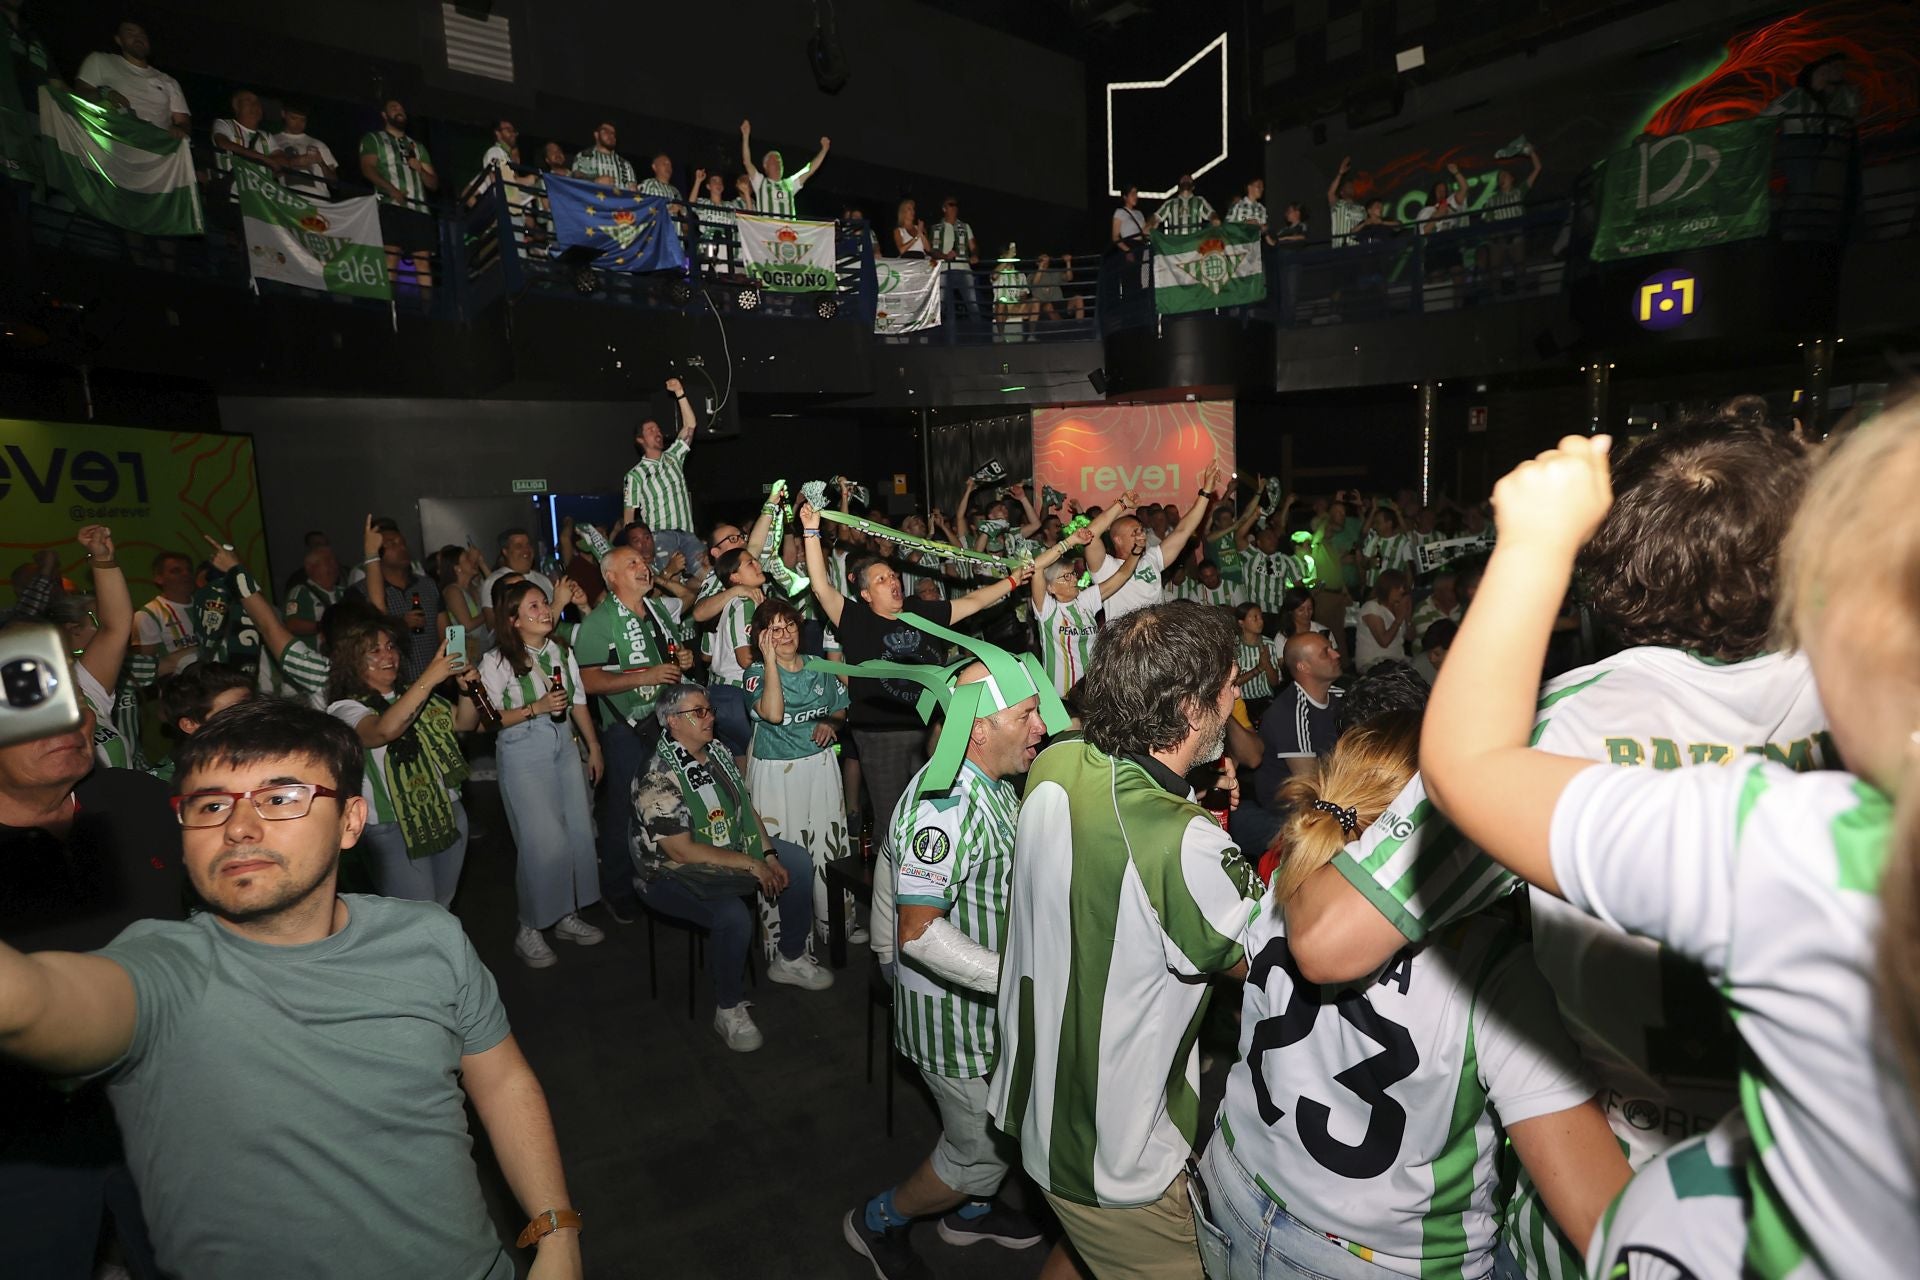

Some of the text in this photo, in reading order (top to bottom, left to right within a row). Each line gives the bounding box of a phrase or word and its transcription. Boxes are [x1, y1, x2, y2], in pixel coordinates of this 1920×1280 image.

[338, 256, 386, 286] alé!
[623, 618, 650, 665] Peña
[902, 866, 948, 883] FOUNDATION
[1247, 936, 1420, 1180] 23
